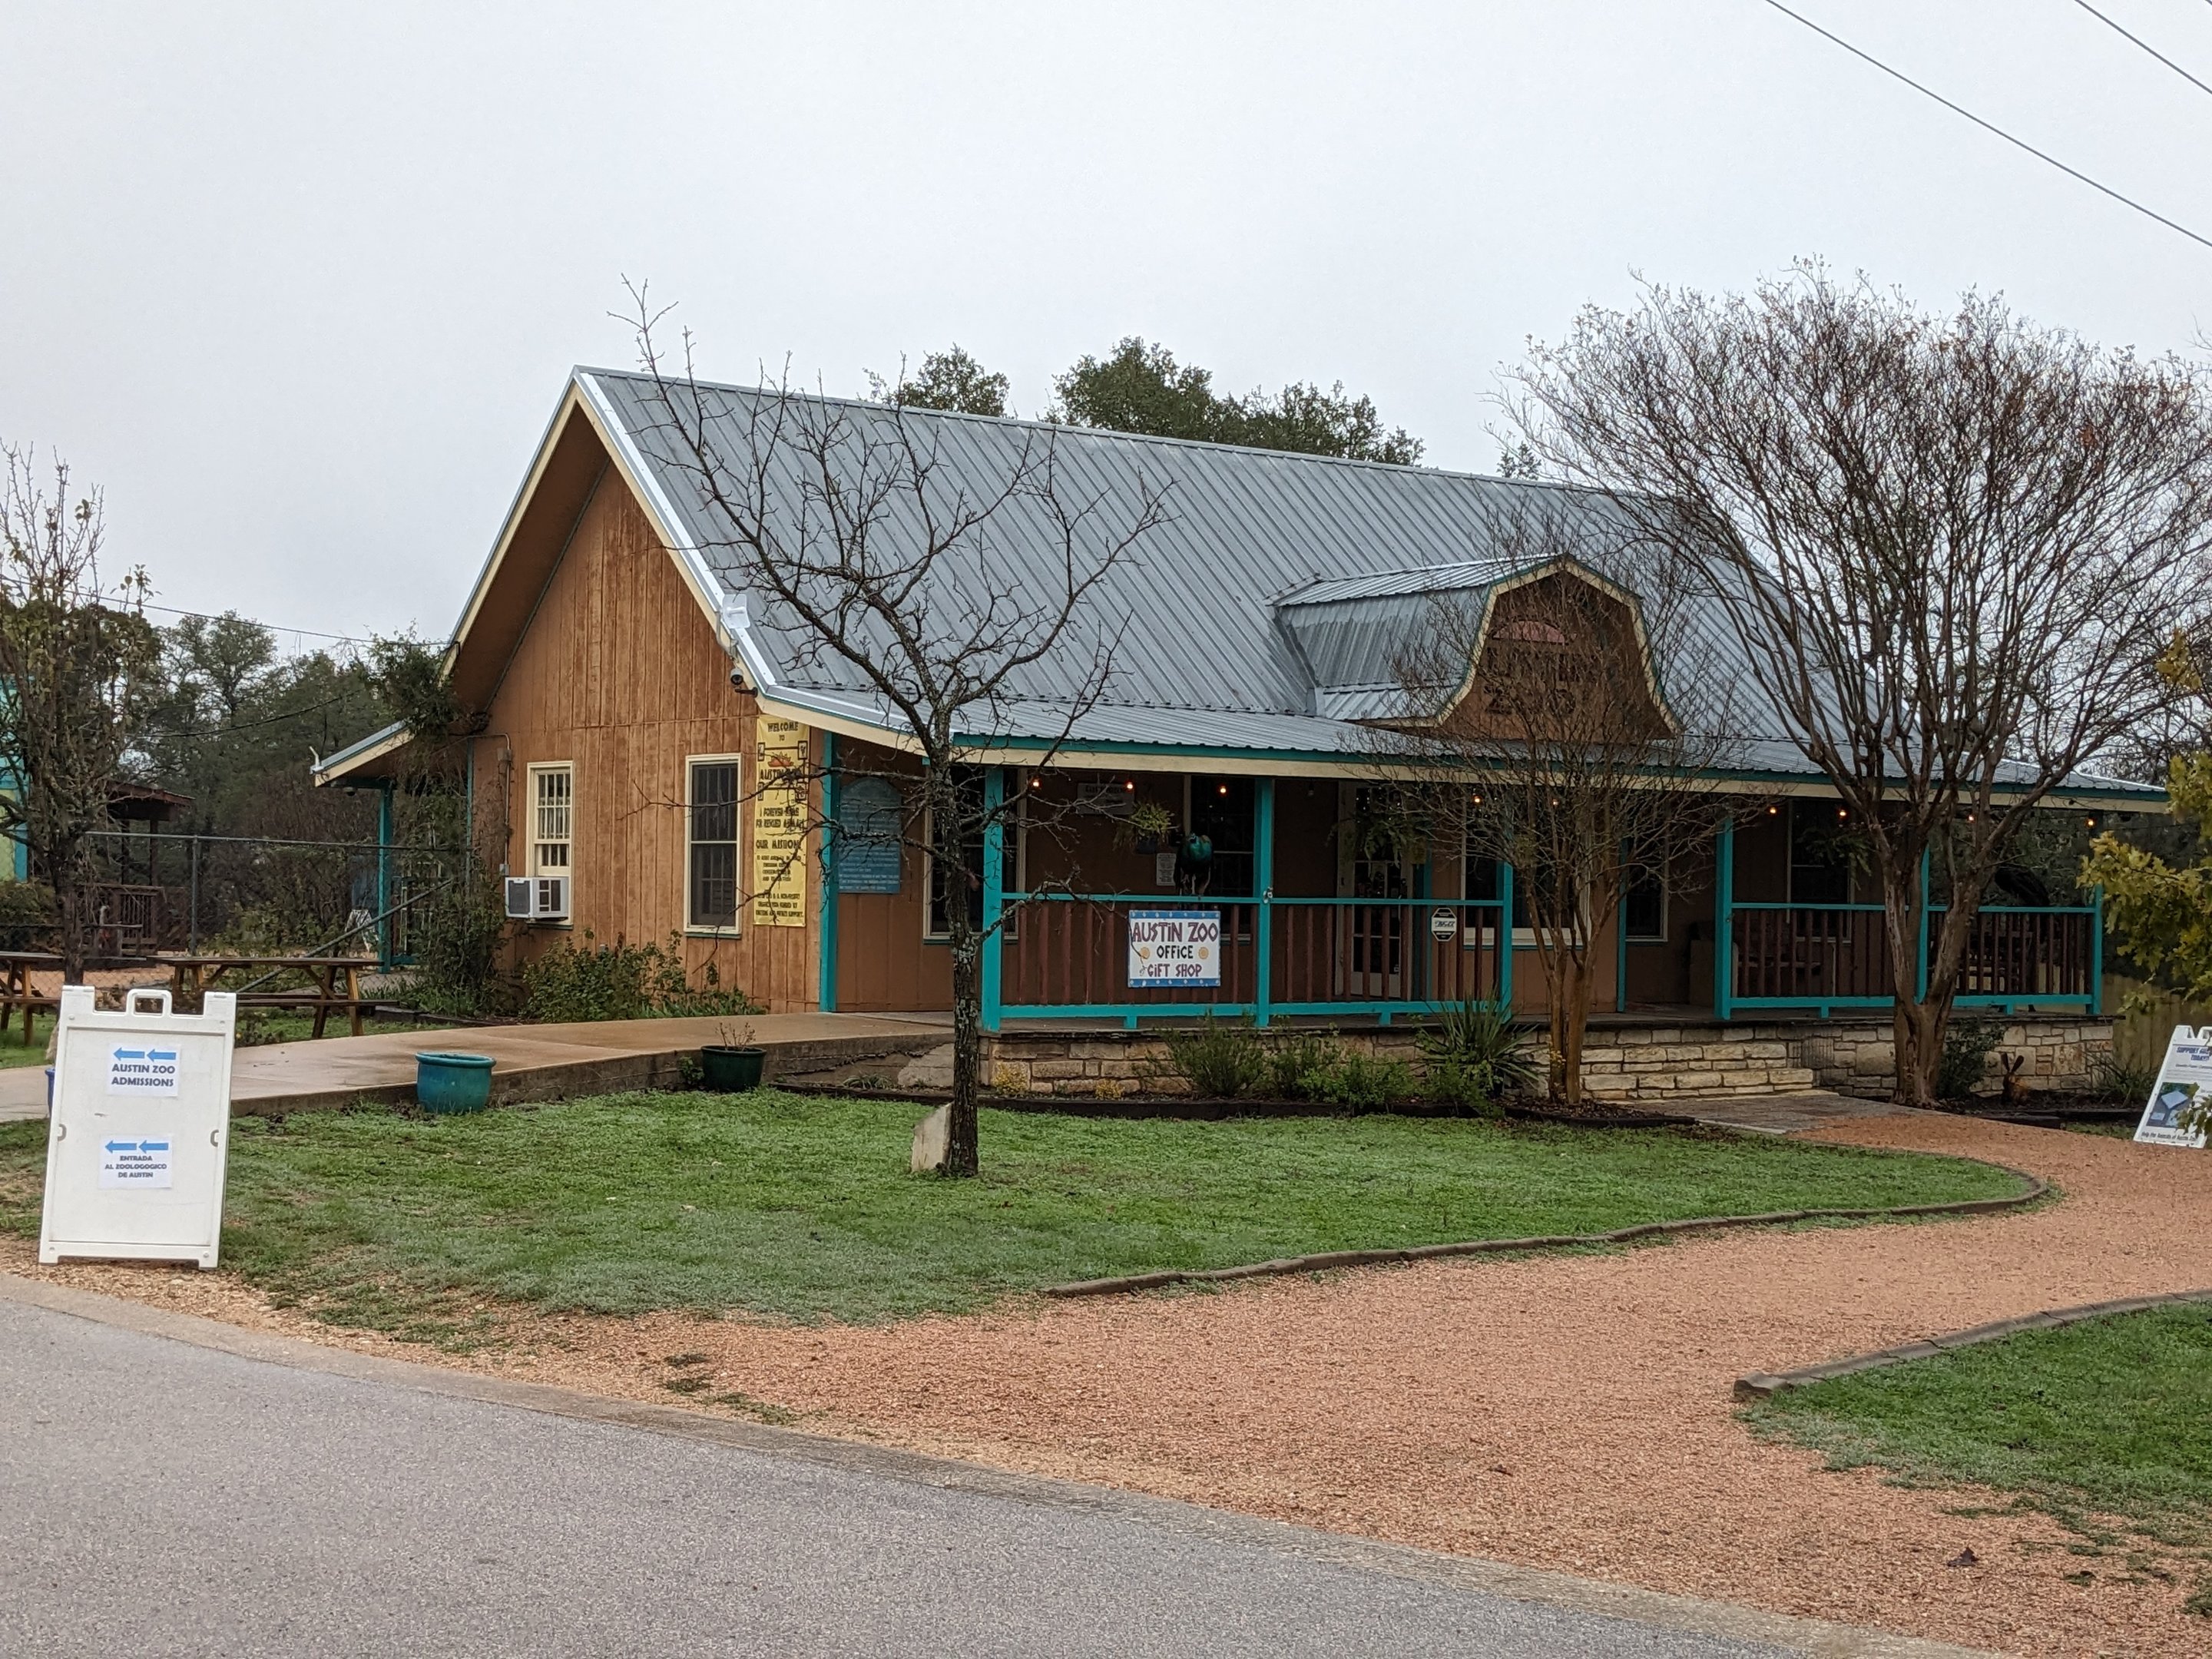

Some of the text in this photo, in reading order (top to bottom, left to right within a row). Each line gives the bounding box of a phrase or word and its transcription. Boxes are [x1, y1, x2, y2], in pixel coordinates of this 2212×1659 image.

[767, 722, 799, 732] WELCOME
[756, 839, 769, 849] OUR
[1187, 922, 1218, 942] ZOO
[1175, 963, 1202, 977] SHOP
[111, 1064, 176, 1074] AUSTIN ZOO
[111, 1076, 174, 1087] ADMISSIONS
